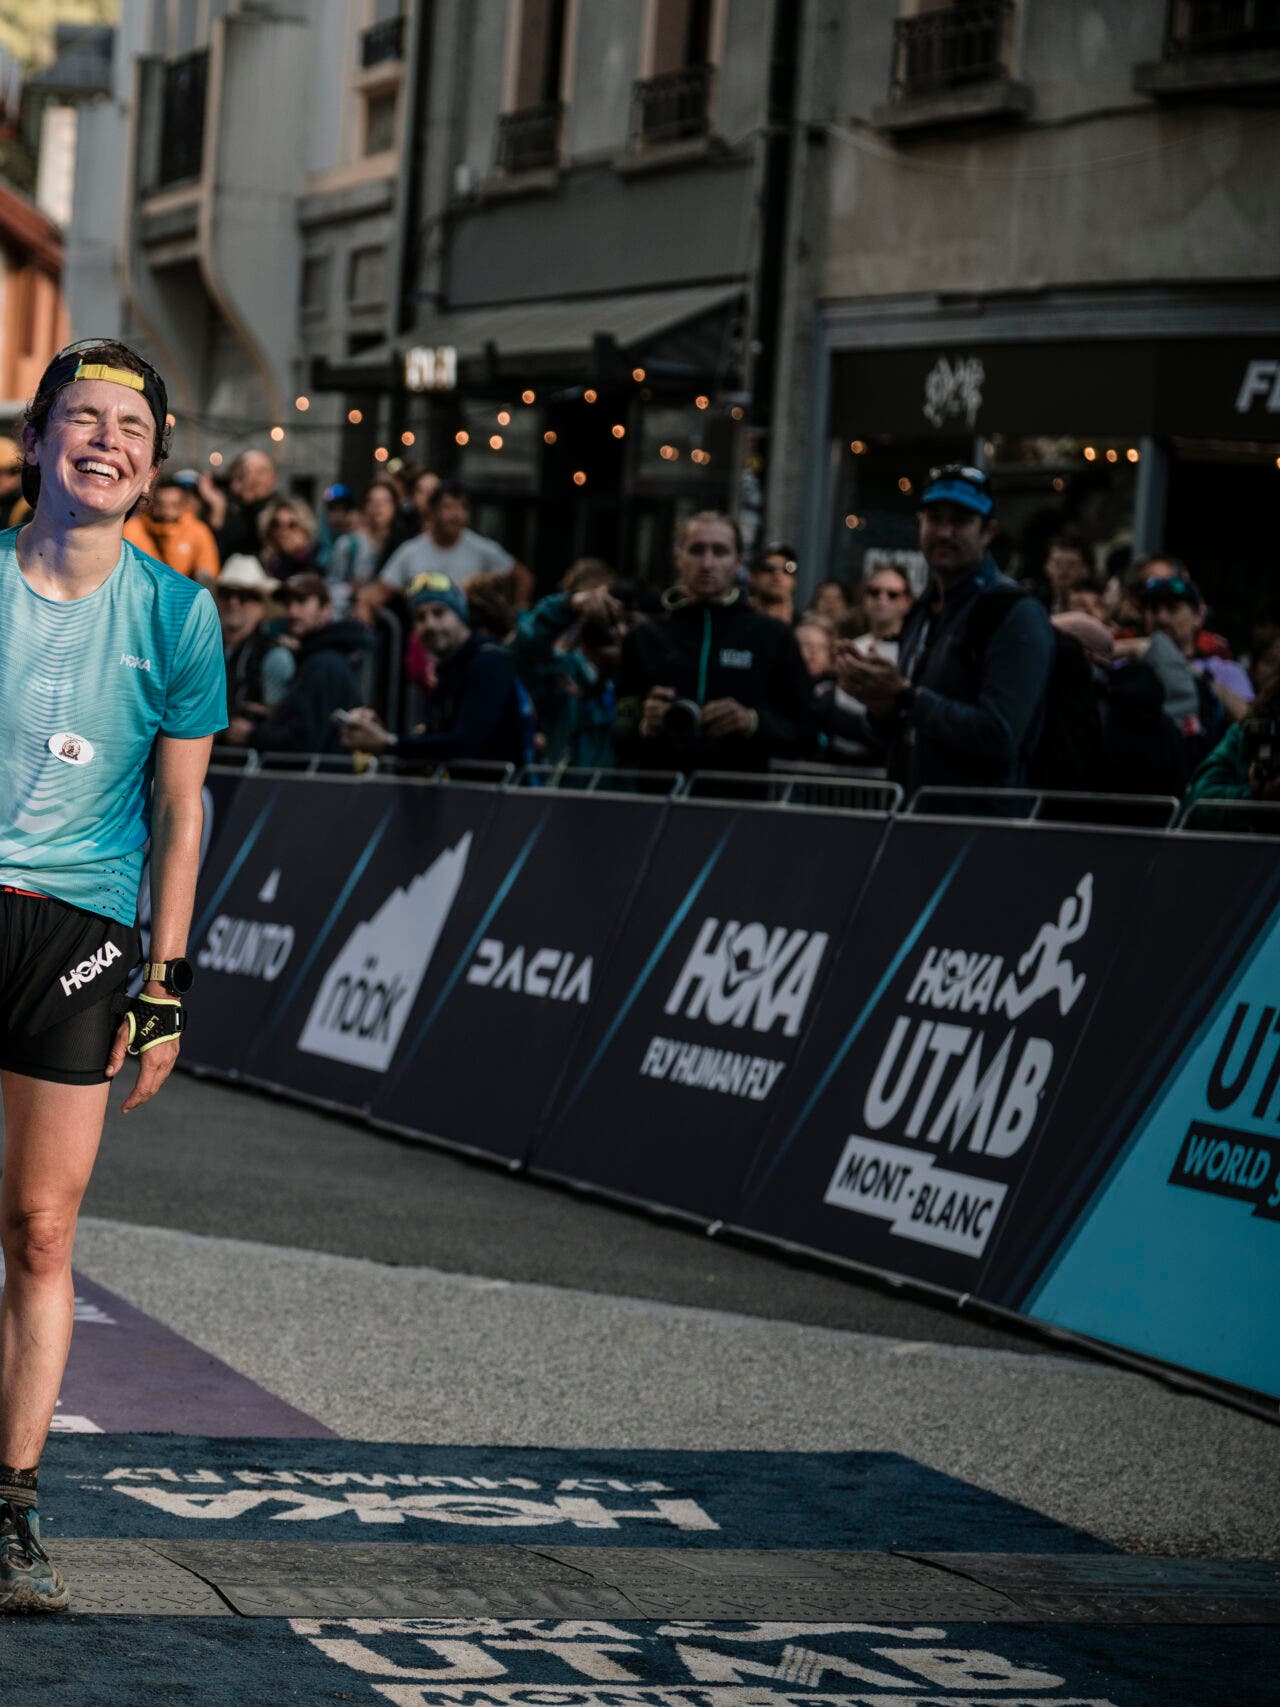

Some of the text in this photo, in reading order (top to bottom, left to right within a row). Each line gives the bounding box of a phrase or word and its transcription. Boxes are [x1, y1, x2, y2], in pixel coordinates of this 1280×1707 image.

[120, 653, 151, 672] HOKA
[60, 941, 122, 997] HOKA
[197, 914, 295, 981] SUUNTO
[466, 938, 594, 1004] DACIA
[664, 916, 829, 1038] HOKA
[905, 945, 1004, 1015] HOKA
[140, 1015, 160, 1037] LEKI
[639, 1035, 786, 1101] FLY HUMAN FLY
[863, 1015, 1055, 1159] UTMB
[1183, 1134, 1271, 1190] WORLD
[102, 1467, 674, 1493] FLY HUMAN FLY
[111, 1484, 721, 1531] HOKA
[288, 1617, 644, 1641] HOKA
[307, 1637, 1067, 1690] UTMB
